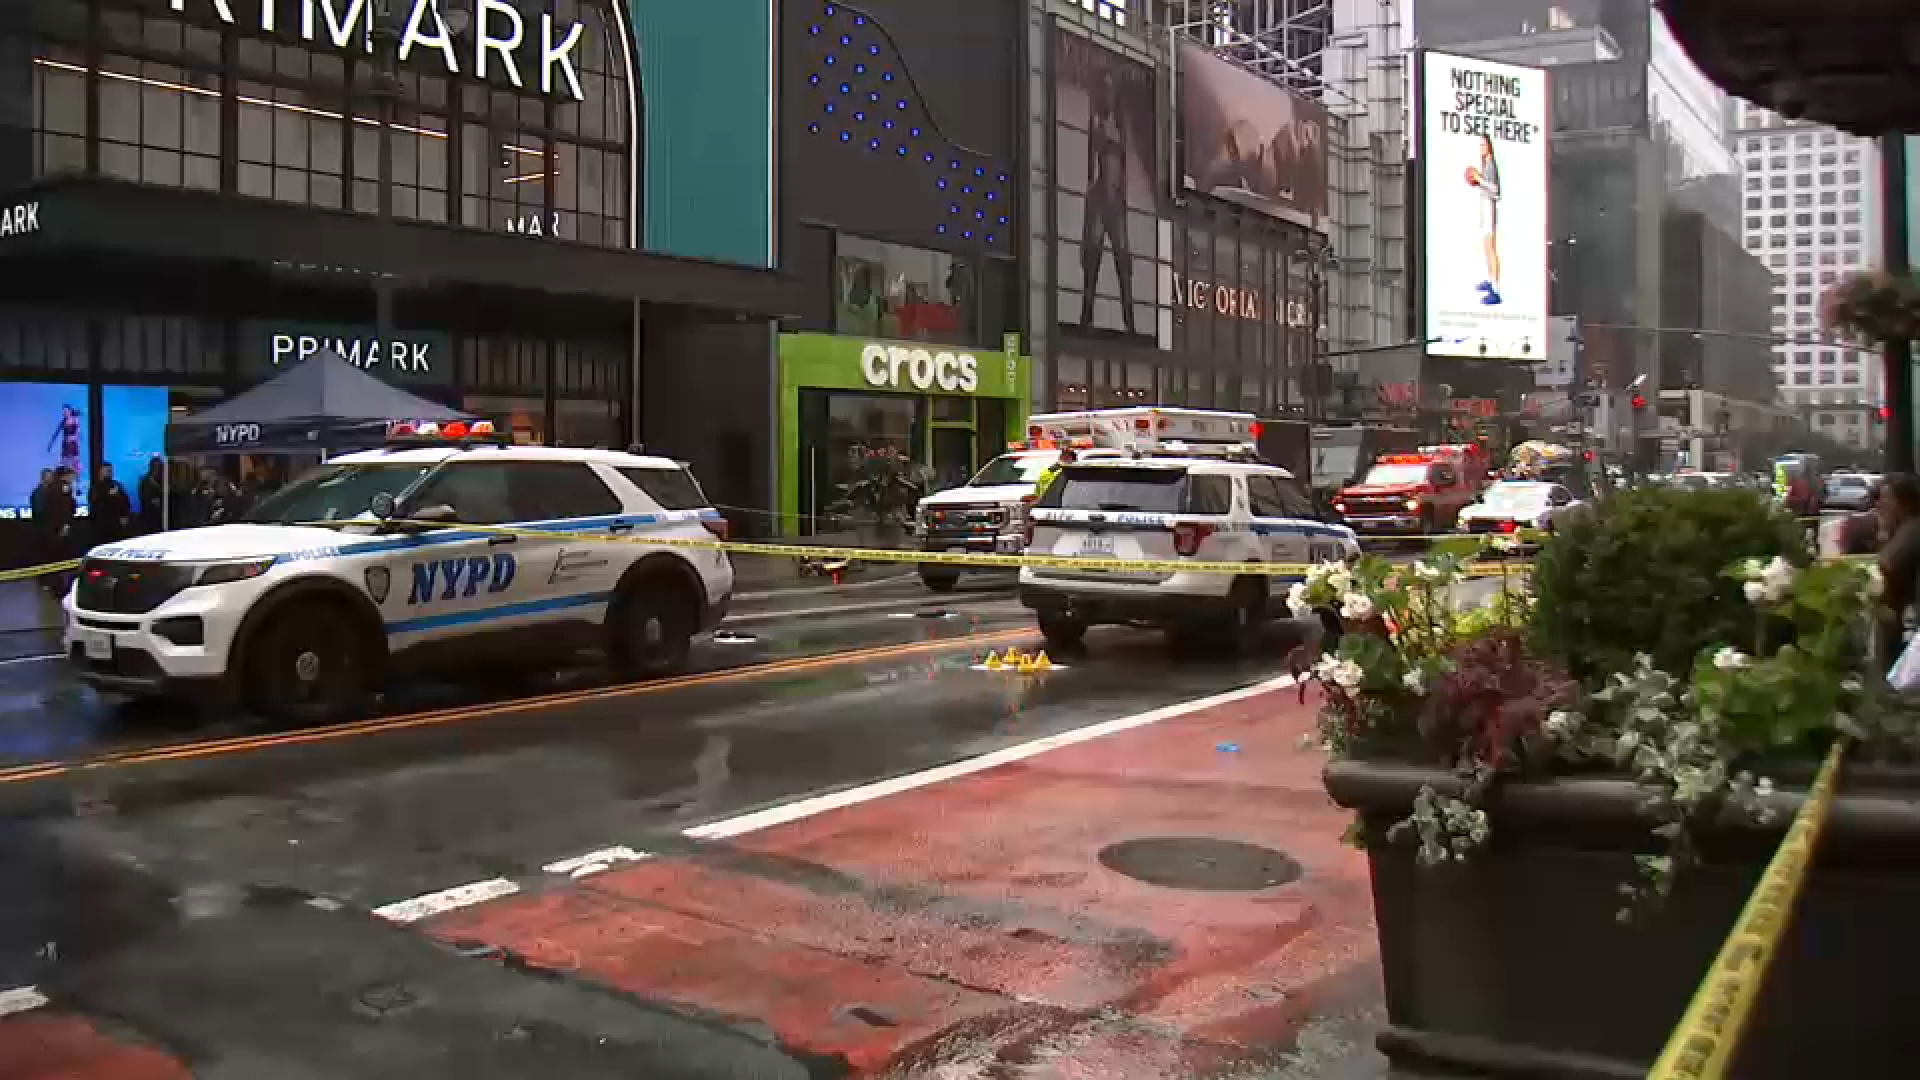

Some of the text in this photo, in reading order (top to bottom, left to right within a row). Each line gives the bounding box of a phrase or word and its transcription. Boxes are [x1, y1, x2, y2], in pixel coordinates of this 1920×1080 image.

[168, 0, 585, 101] MARK
[1450, 67, 1521, 98] NOTHING
[1454, 91, 1517, 119] SPECIAL
[1440, 110, 1461, 134] TO
[1463, 114, 1492, 137] SEE
[0, 201, 40, 237] ARK
[863, 343, 979, 392] crocs
[216, 423, 260, 442] NYPD
[407, 552, 517, 605] NYPD
